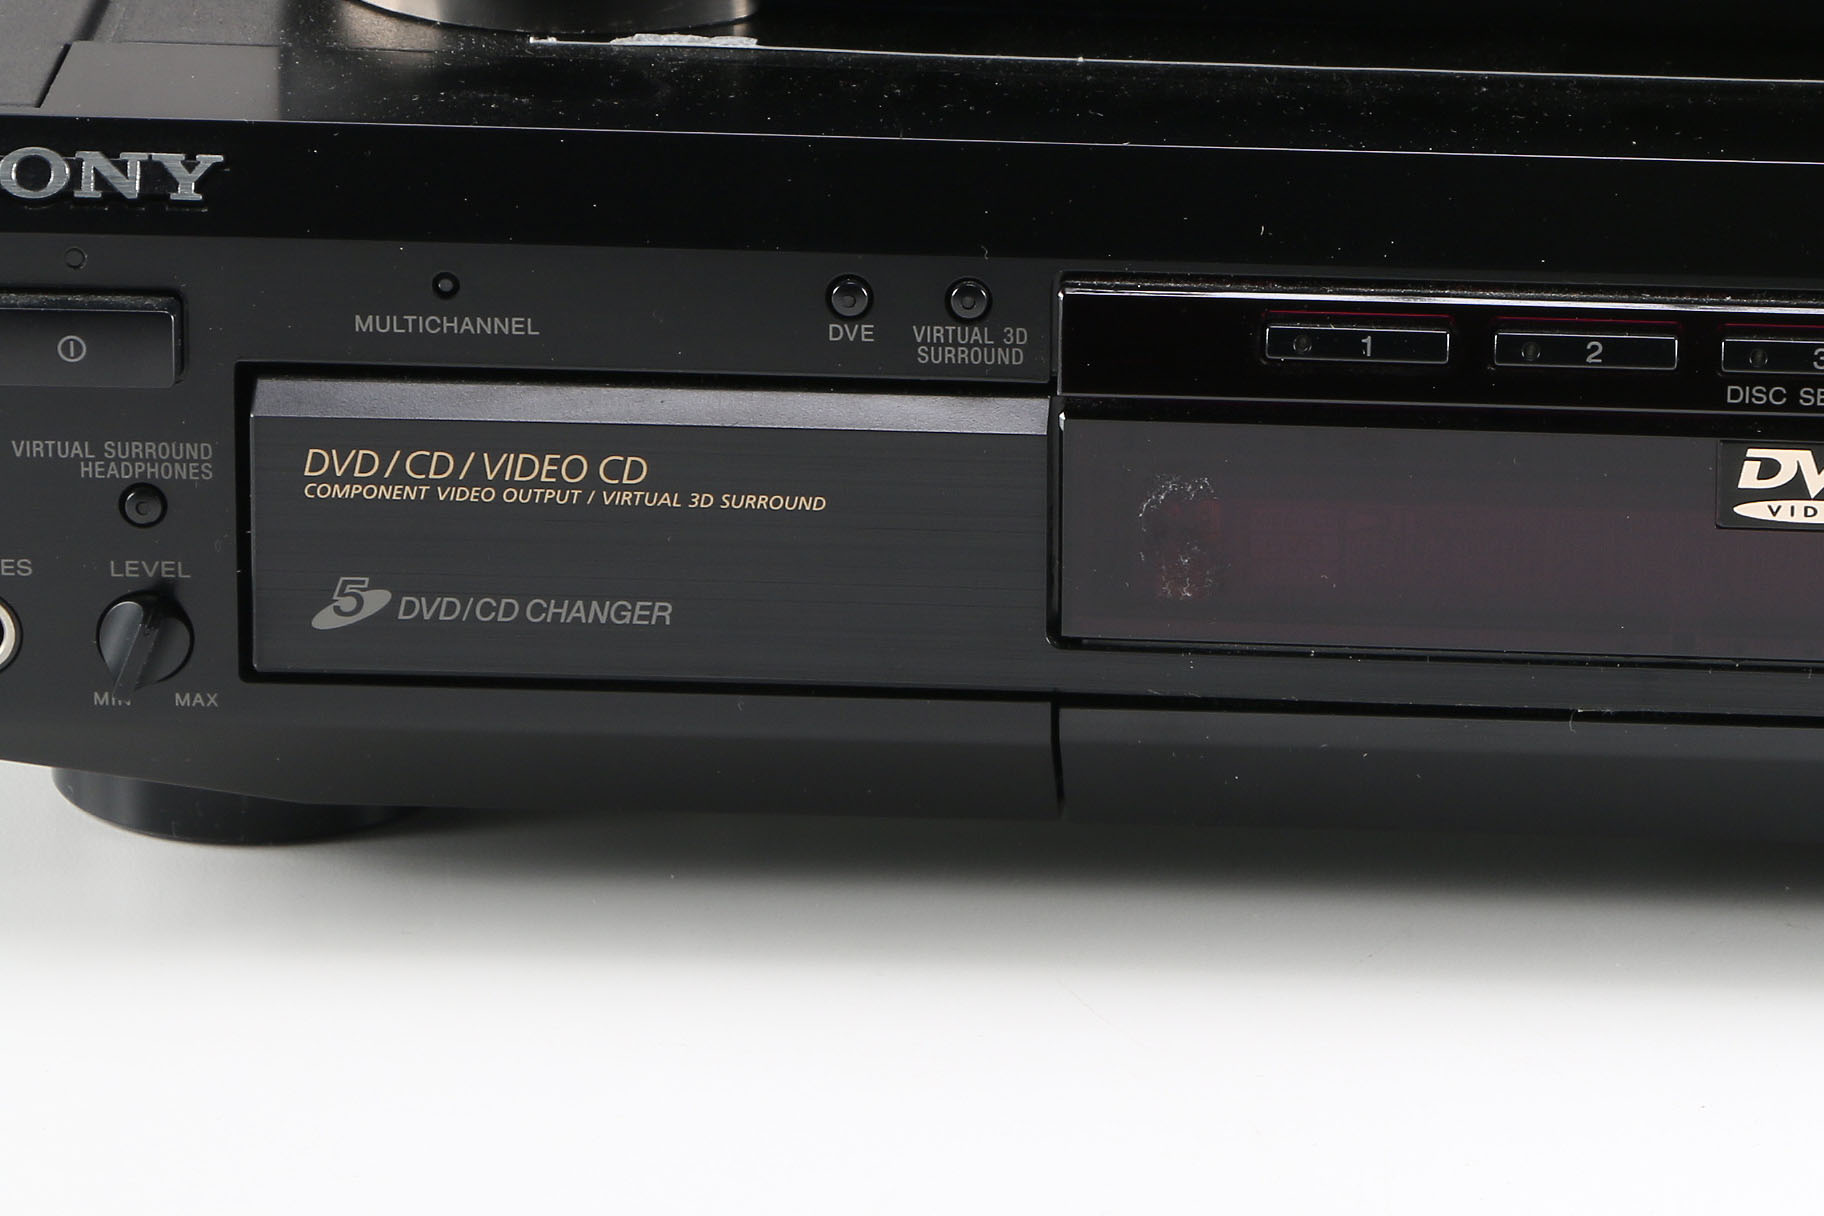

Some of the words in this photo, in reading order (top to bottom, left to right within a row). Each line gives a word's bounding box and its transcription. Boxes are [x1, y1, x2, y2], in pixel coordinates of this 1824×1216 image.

[0, 146, 224, 201] ONY
[354, 314, 540, 336] MULTICHANNEL
[828, 324, 875, 343] DVE
[913, 325, 994, 345] VIRTUAL
[1003, 327, 1028, 346] 3D
[917, 346, 1024, 366] SURROUND
[1359, 335, 1372, 357] 1
[1584, 340, 1603, 364] 2
[1727, 384, 1791, 409] DISC
[11, 439, 96, 459] VIRTUAL
[104, 441, 213, 460] SURROUND
[80, 460, 214, 480] HEADPHONES
[598, 455, 648, 484] CD
[304, 483, 430, 501] COMPONENT
[436, 486, 496, 503] VIDEO
[502, 487, 581, 505] OUTPUT
[602, 490, 682, 507] VIRTUAL
[688, 492, 714, 509] 3D
[720, 493, 827, 512] SURROUND
[110, 560, 191, 578] LEVEL
[397, 596, 519, 622] DVD/CD
[526, 599, 672, 625] CHANGER
[175, 693, 218, 707] MAX
